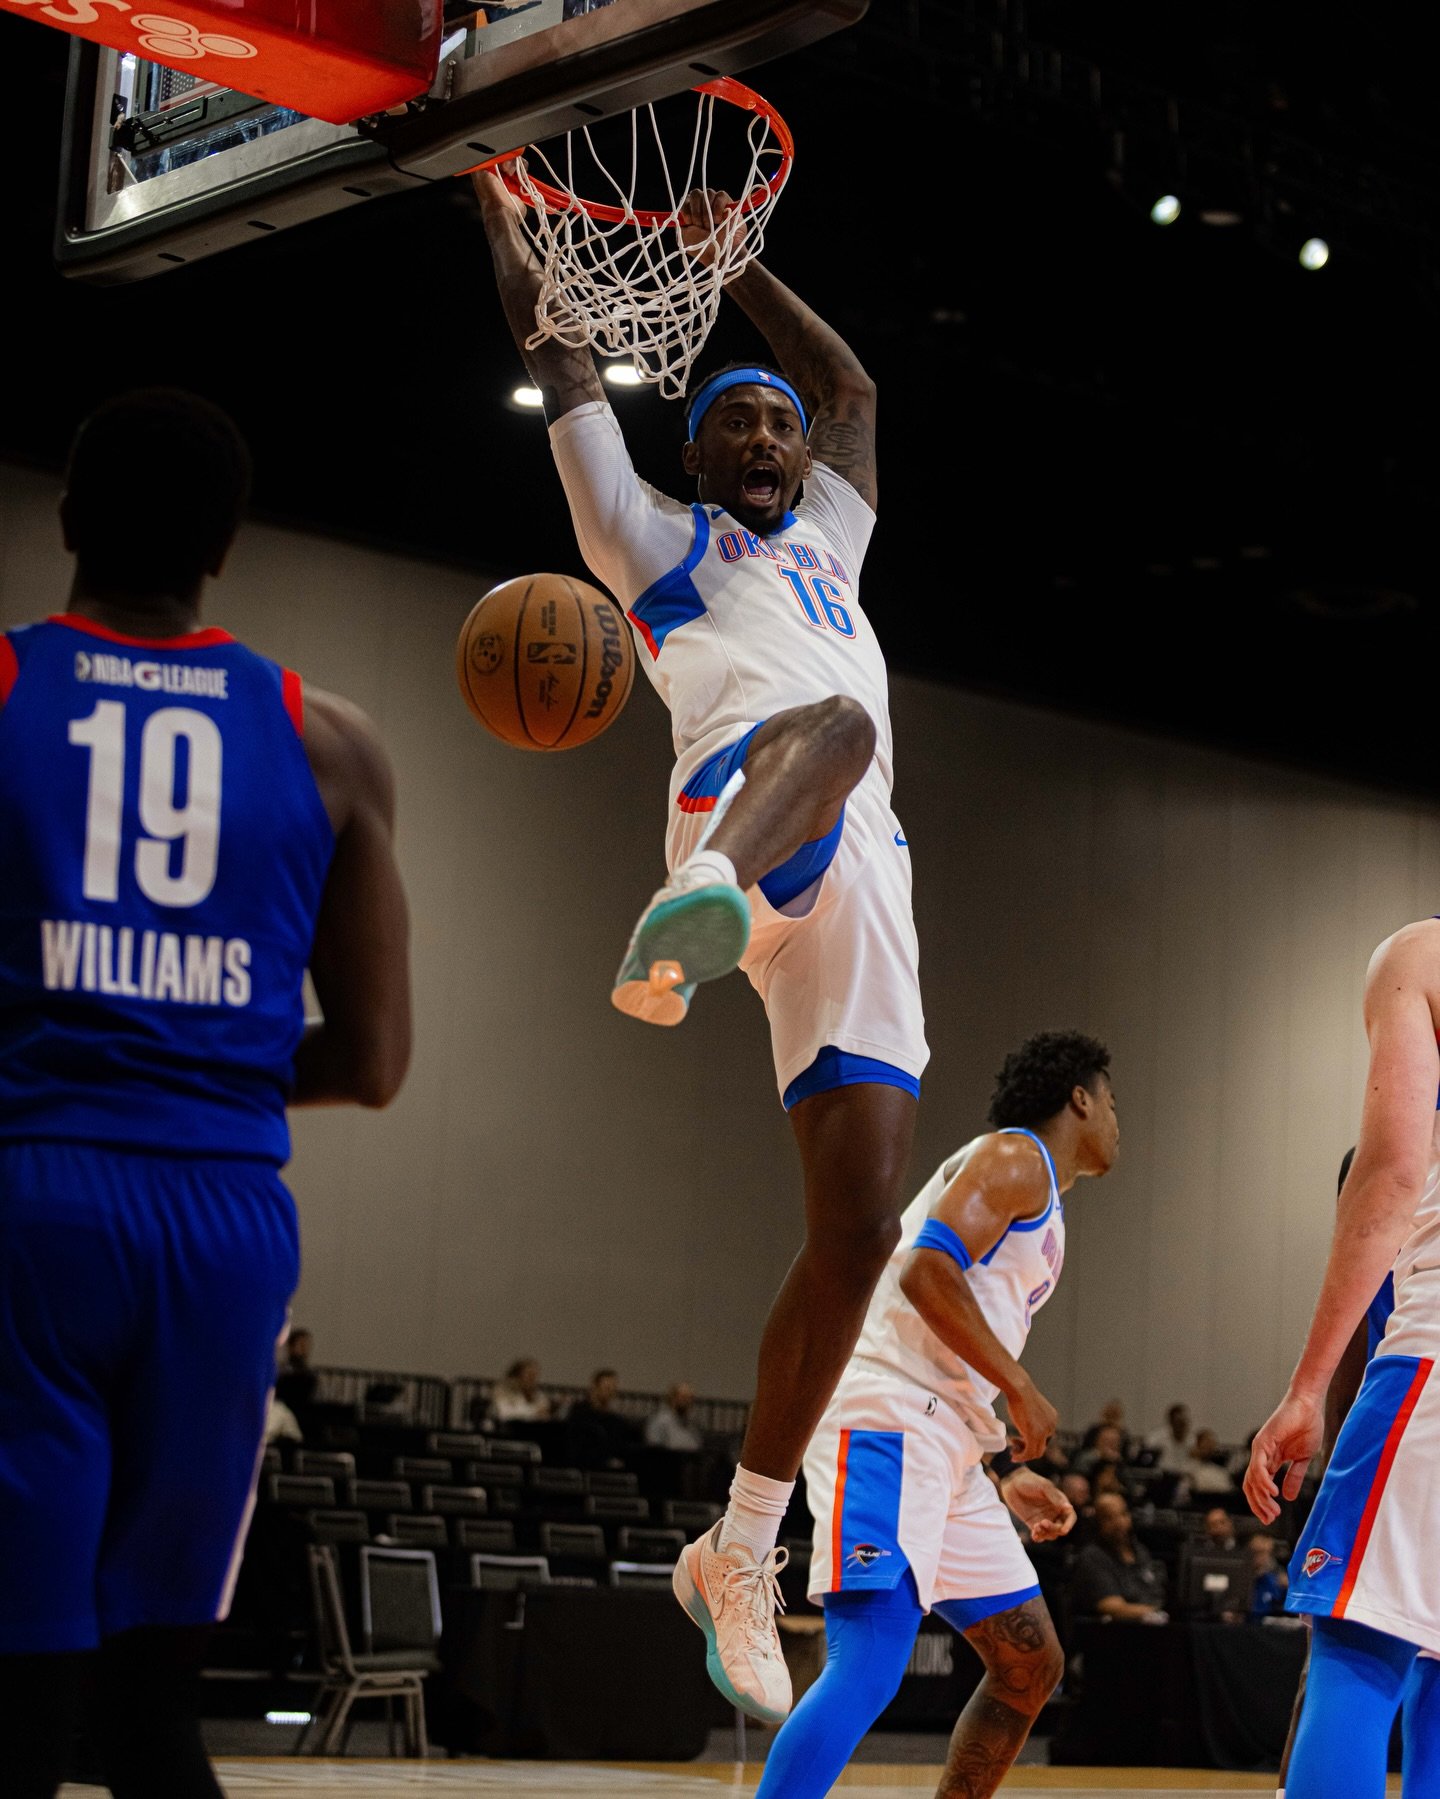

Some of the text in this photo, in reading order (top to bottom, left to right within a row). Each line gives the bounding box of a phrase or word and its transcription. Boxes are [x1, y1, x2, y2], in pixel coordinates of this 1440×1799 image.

[777, 563, 857, 640] 16
[584, 603, 623, 719] Wilson
[68, 699, 223, 909] 19
[41, 918, 252, 1008] WILLIAMS
